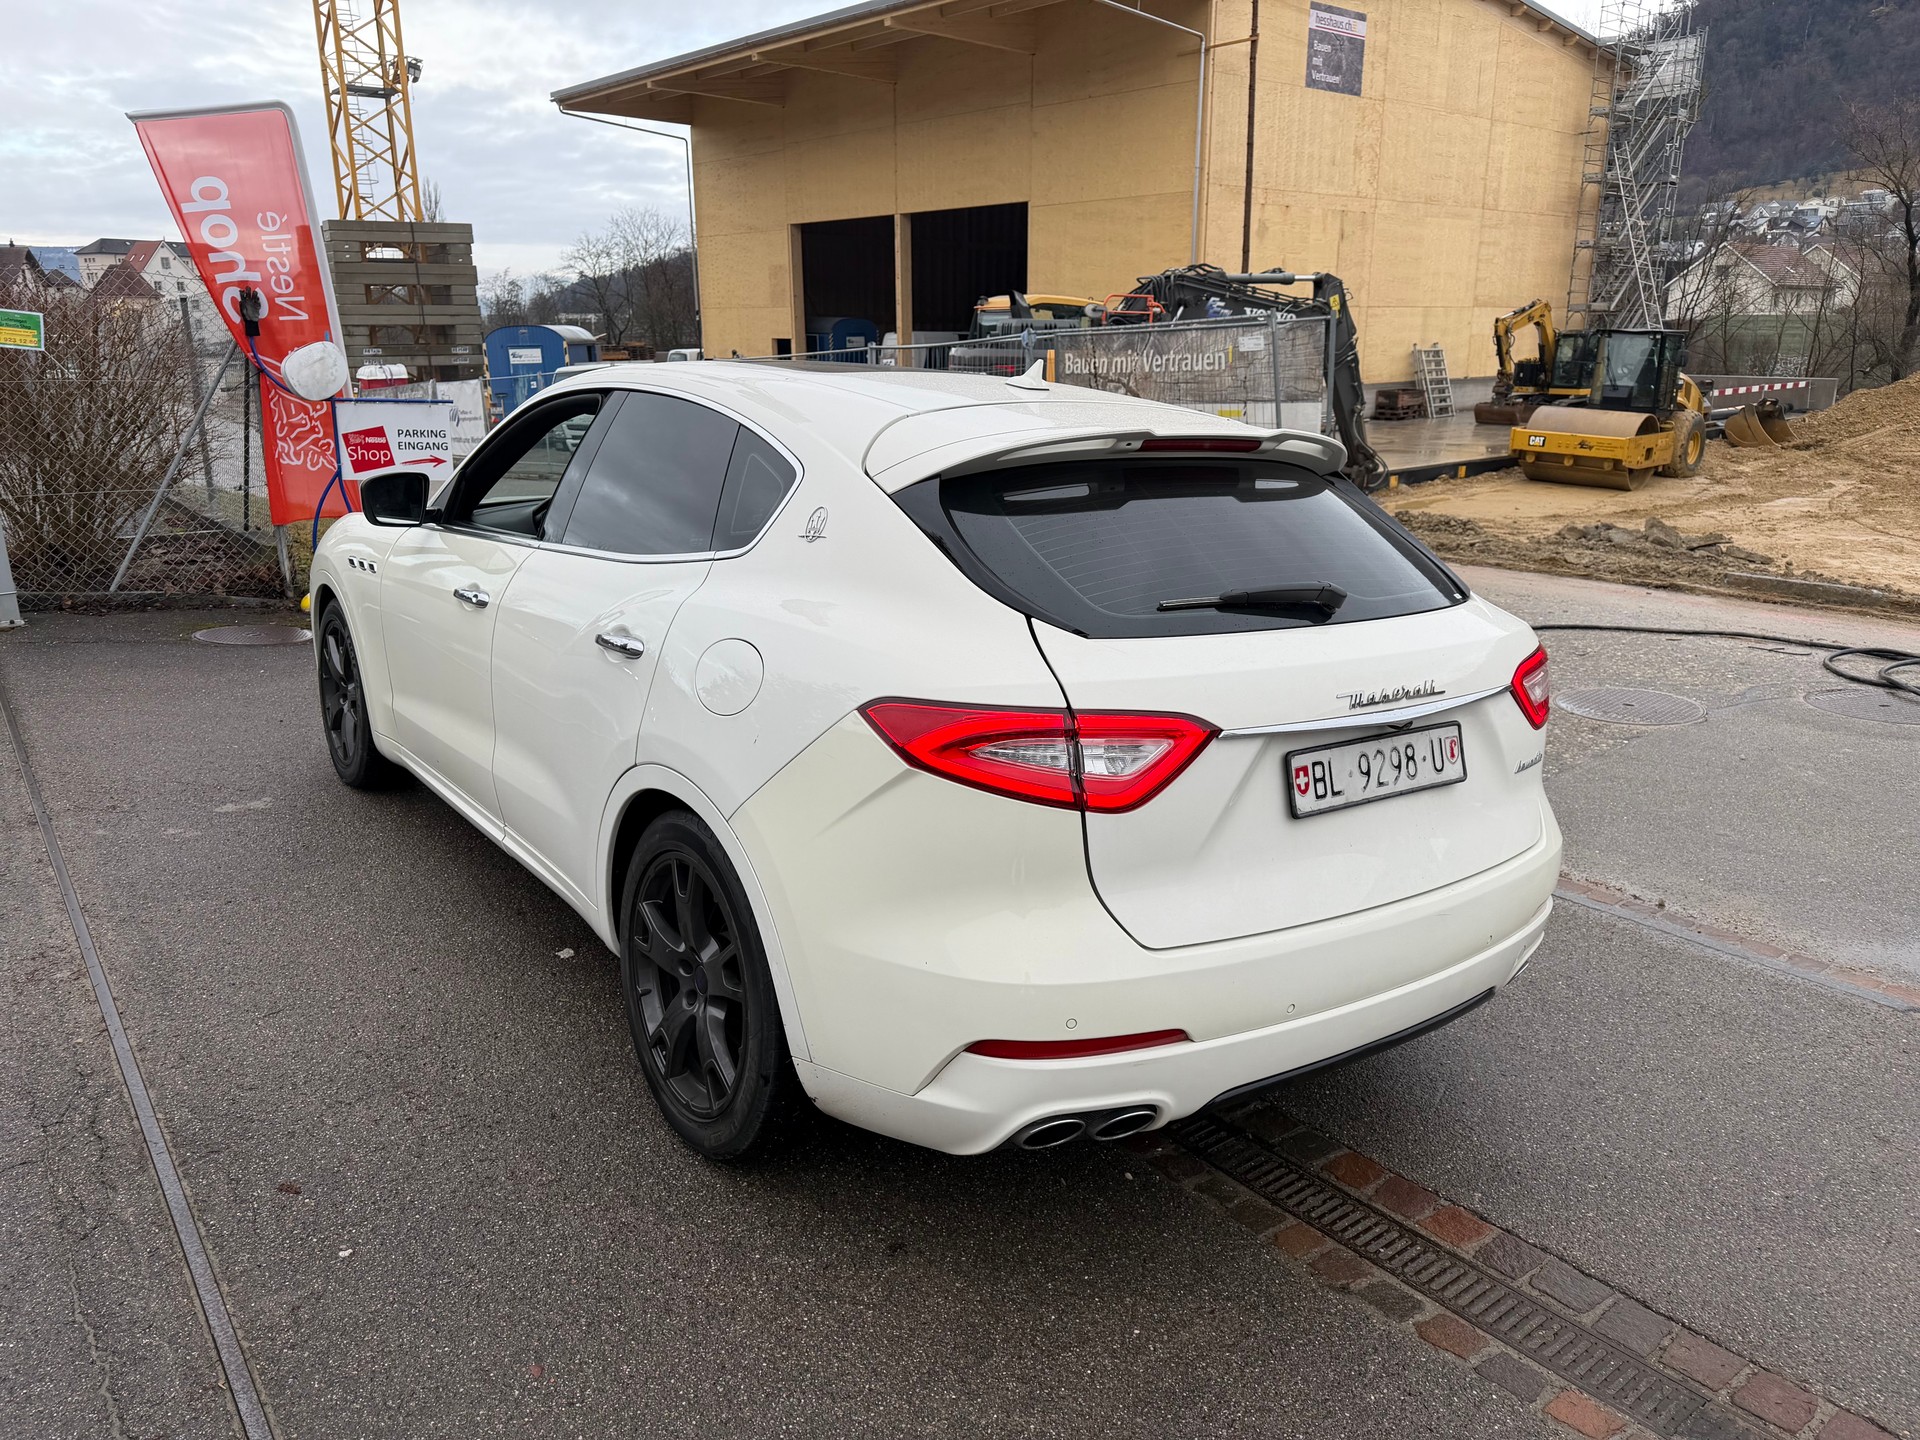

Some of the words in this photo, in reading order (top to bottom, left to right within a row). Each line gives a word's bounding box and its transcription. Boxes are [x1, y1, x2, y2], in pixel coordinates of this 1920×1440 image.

[1315, 12, 1353, 31] hesshaus.ch
[1313, 40, 1332, 53] Bauen
[1312, 55, 1323, 66] mit
[1064, 353, 1108, 375] Bauen
[1112, 350, 1140, 374] mit
[397, 429, 447, 439] PARKING
[397, 441, 449, 451] EINGANG
[1529, 436, 1545, 447] CAT
[347, 445, 391, 464] Shop
[1311, 758, 1344, 800] BL
[1357, 743, 1418, 792] 9298
[1430, 737, 1445, 774] U
